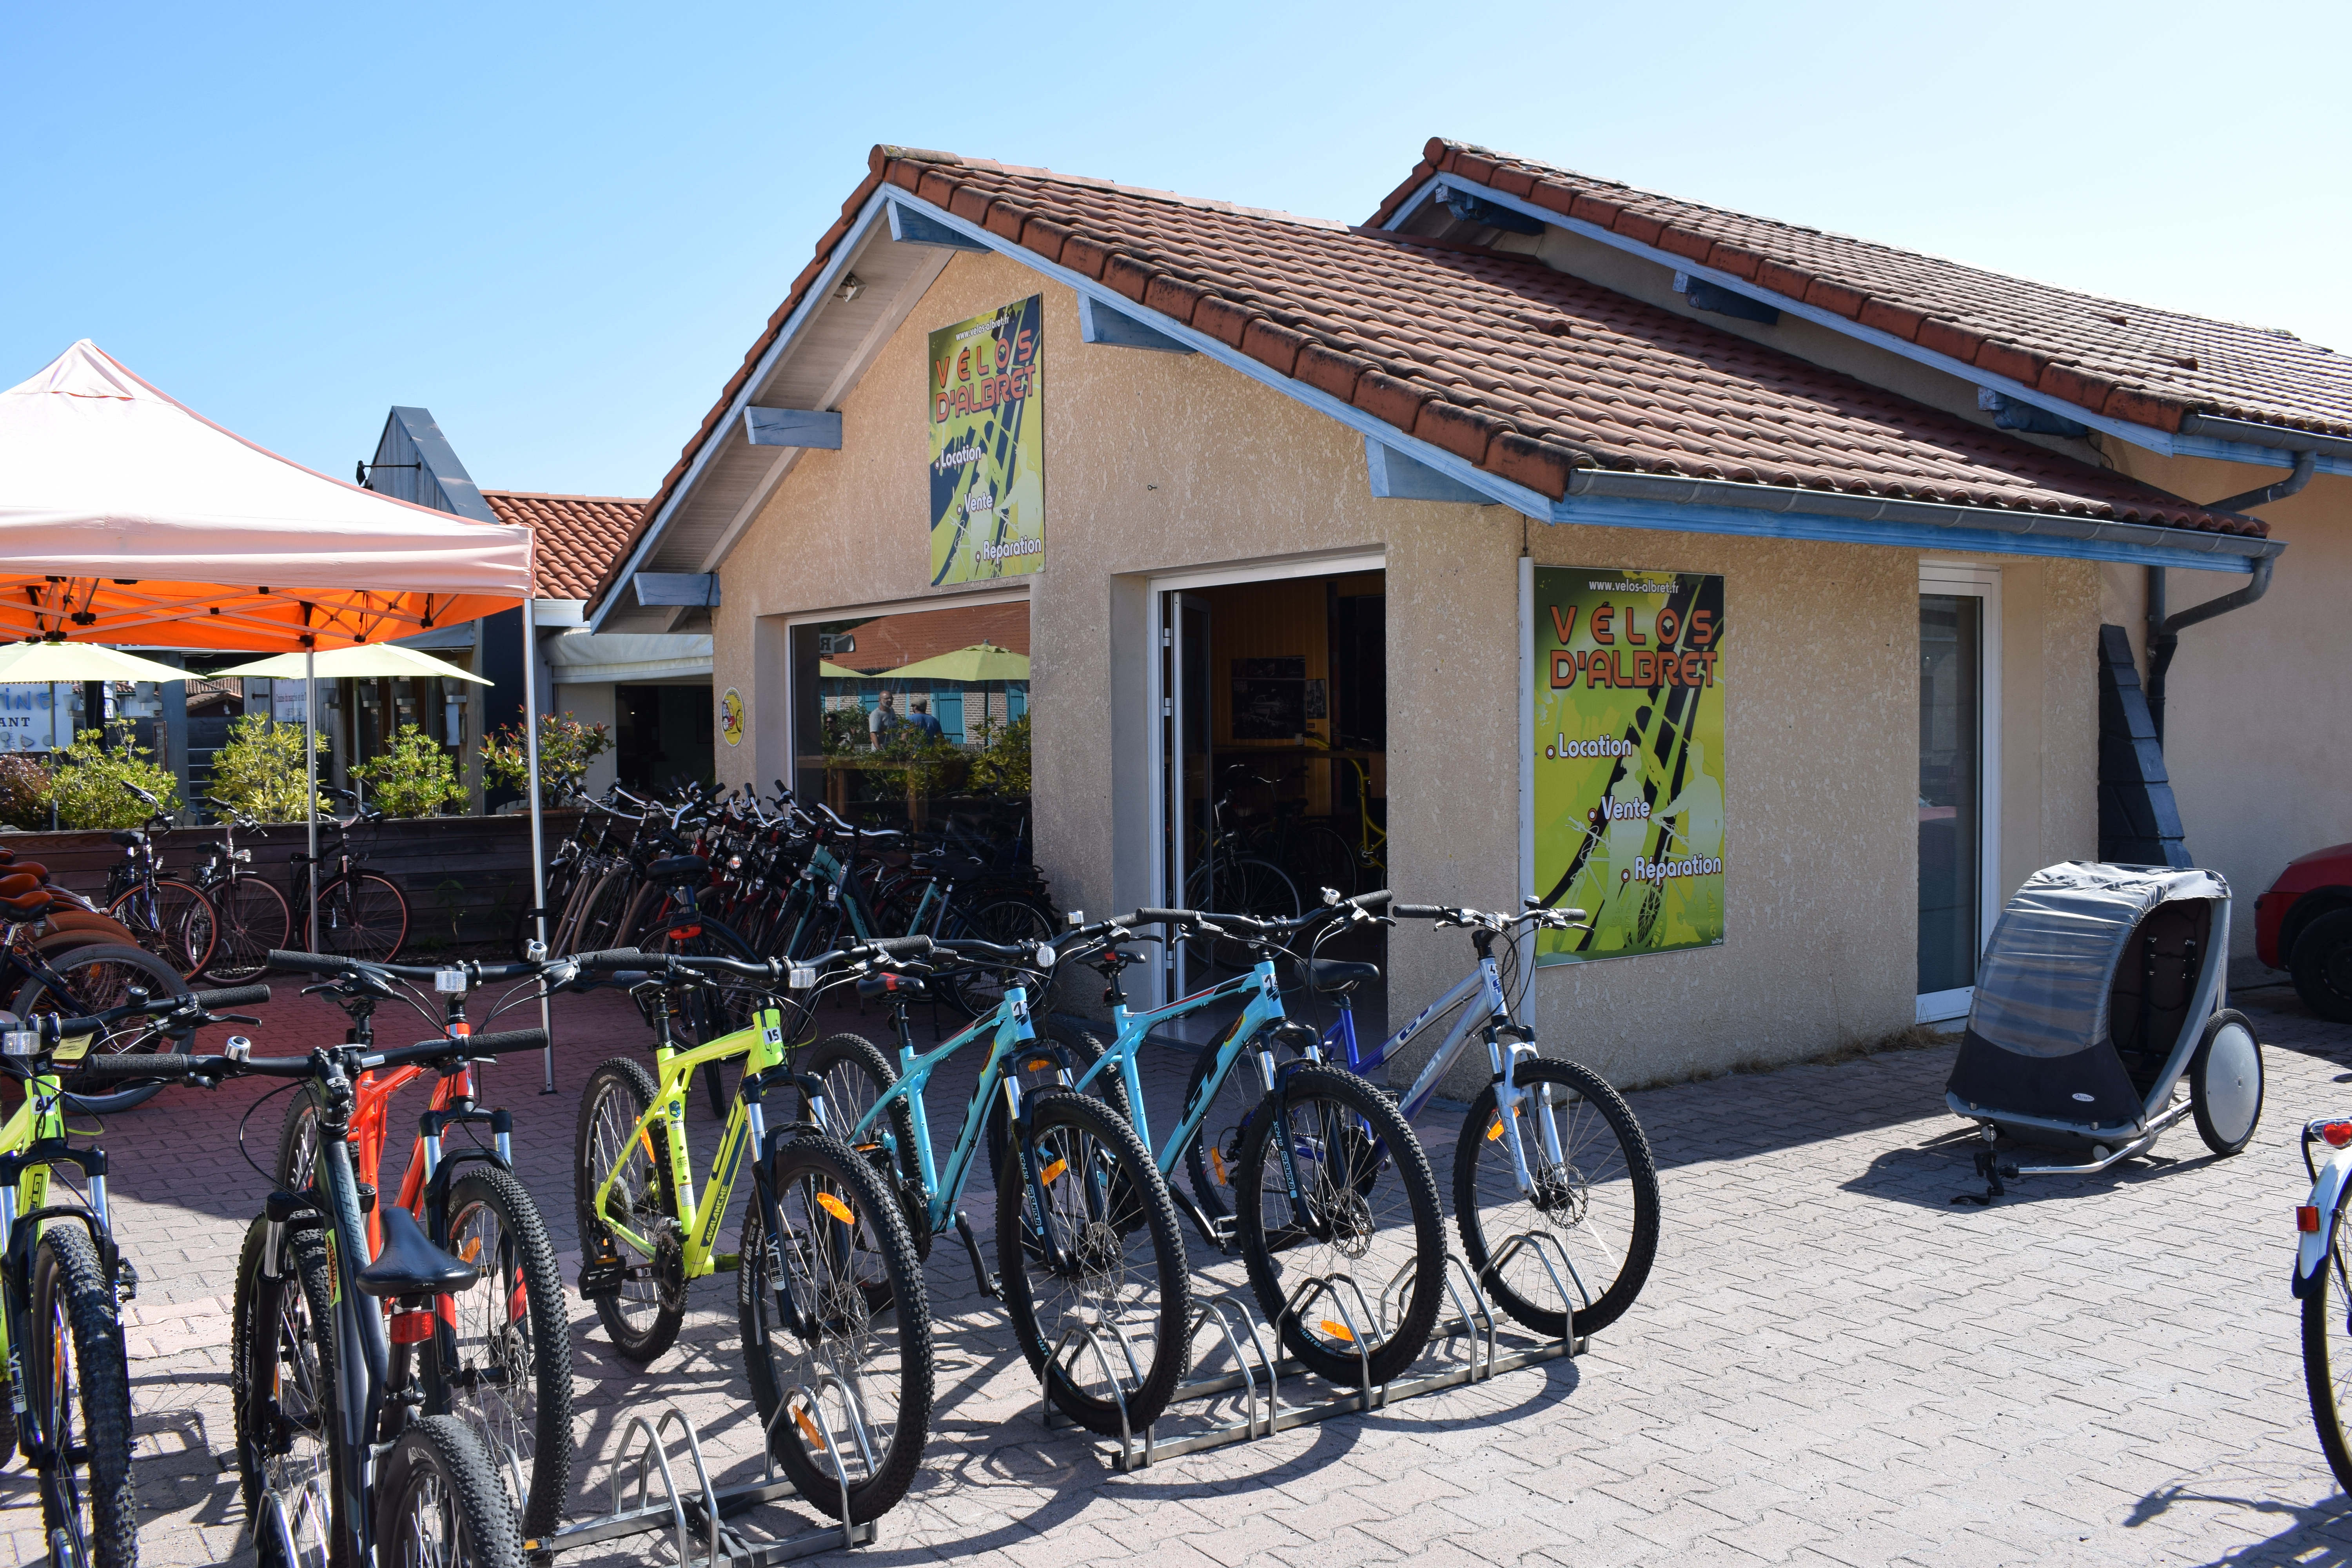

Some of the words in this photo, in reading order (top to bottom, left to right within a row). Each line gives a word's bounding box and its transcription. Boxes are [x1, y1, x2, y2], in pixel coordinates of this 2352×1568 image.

[955, 316, 1010, 341] www.velos-albret.fr
[935, 328, 1033, 389] VÉLOS
[936, 364, 1036, 424] D'ALBRET
[941, 444, 982, 468] Location
[964, 492, 993, 514] Vente
[983, 537, 1042, 565] Réparation
[1589, 579, 1679, 595] www.velos-albret.fr
[1550, 601, 1714, 646] VÉLOS
[1550, 649, 1717, 690] D'ALBRET
[1558, 732, 1632, 758] Location
[1601, 796, 1651, 820] Vente
[1634, 854, 1722, 882] Réparation
[767, 1029, 780, 1042] 15
[706, 1185, 728, 1243] AVALANCHE
[744, 1241, 753, 1261] SIX
[742, 1260, 751, 1294] SLANT
[1301, 1330, 1322, 1348] WTB
[235, 1337, 244, 1393] cypher
